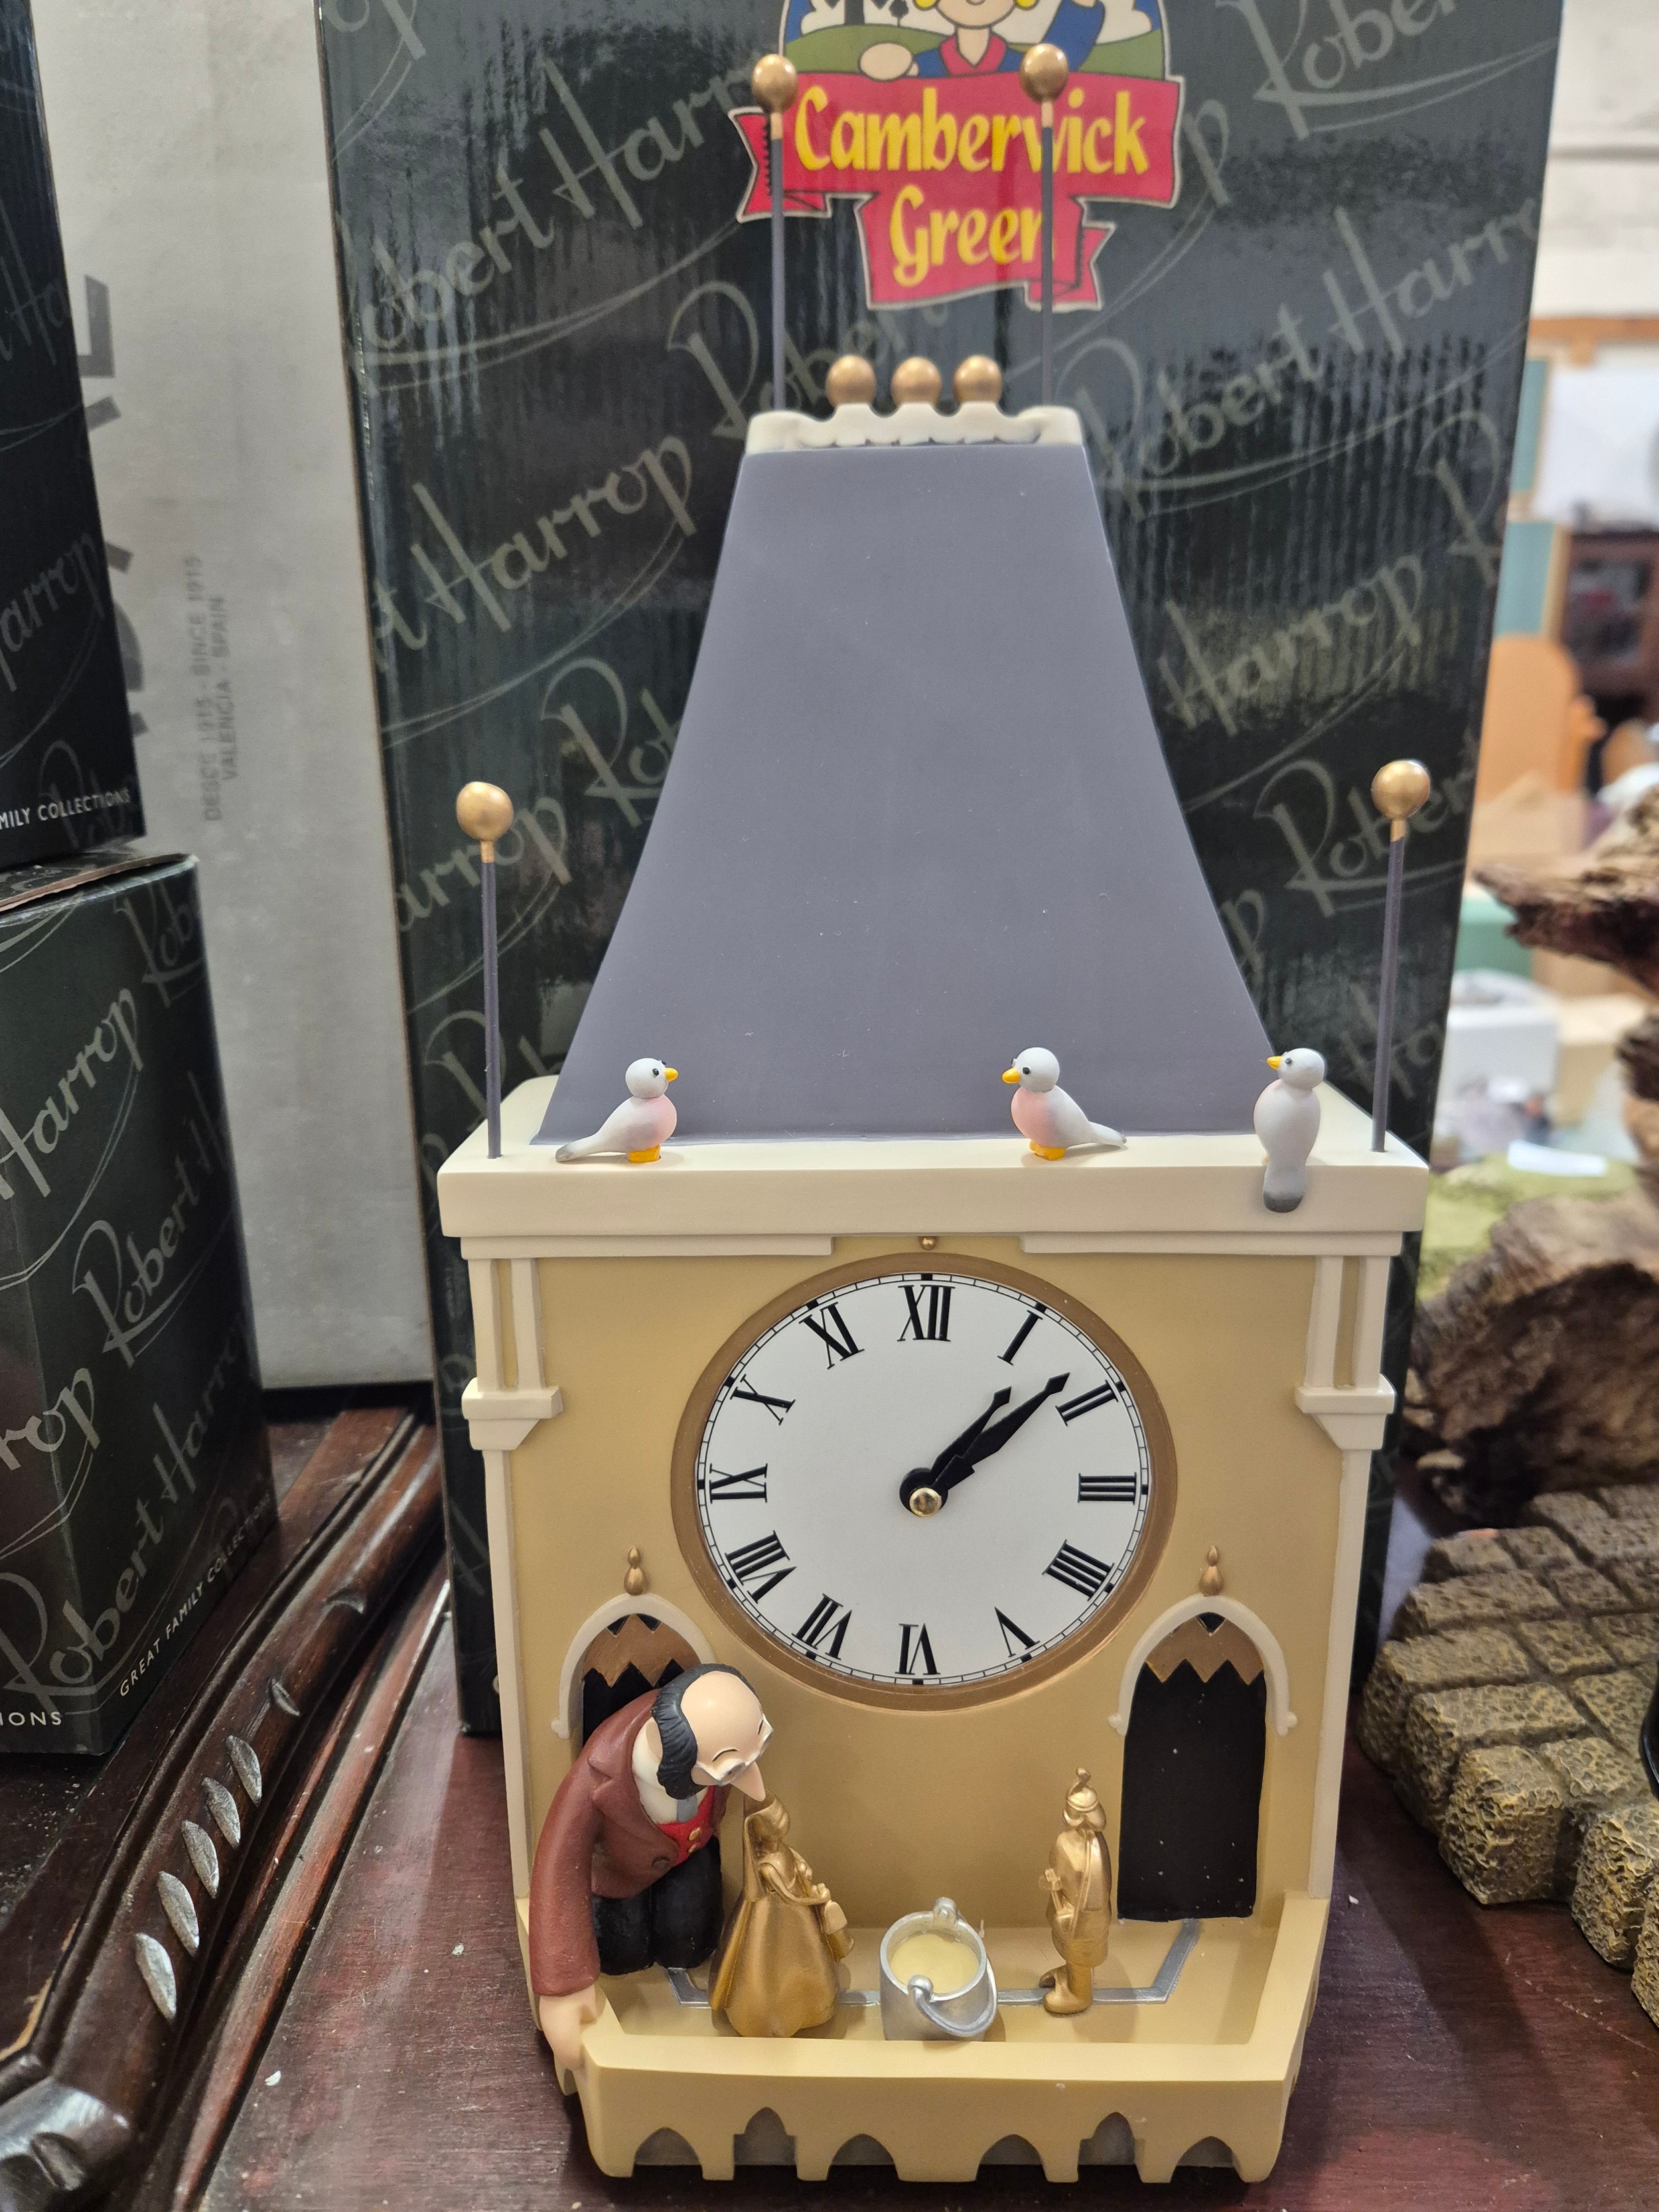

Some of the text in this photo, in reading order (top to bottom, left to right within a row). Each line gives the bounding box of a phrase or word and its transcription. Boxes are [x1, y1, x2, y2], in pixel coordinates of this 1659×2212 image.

[538, 58, 755, 230] Harr
[796, 85, 1149, 175] Camberwick
[410, 435, 697, 632] Harrop
[1157, 555, 1423, 737] Harrop
[215, 679, 239, 781] VALENCIA
[71, 1153, 199, 1369] Robert
[799, 1302, 865, 1369] XI
[897, 1284, 955, 1341] XII
[730, 1374, 796, 1425] X
[1055, 1379, 1119, 1426] II
[709, 1463, 768, 1503] IX
[1078, 1472, 1137, 1505] III
[725, 1530, 797, 1604] VIII
[1042, 1539, 1115, 1601] IIII
[119, 1637, 161, 1697] GREAT
[165, 1580, 204, 1641] FAMILY
[792, 1593, 853, 1660] VII
[895, 1623, 940, 1676] VI
[995, 1606, 1041, 1658] V
